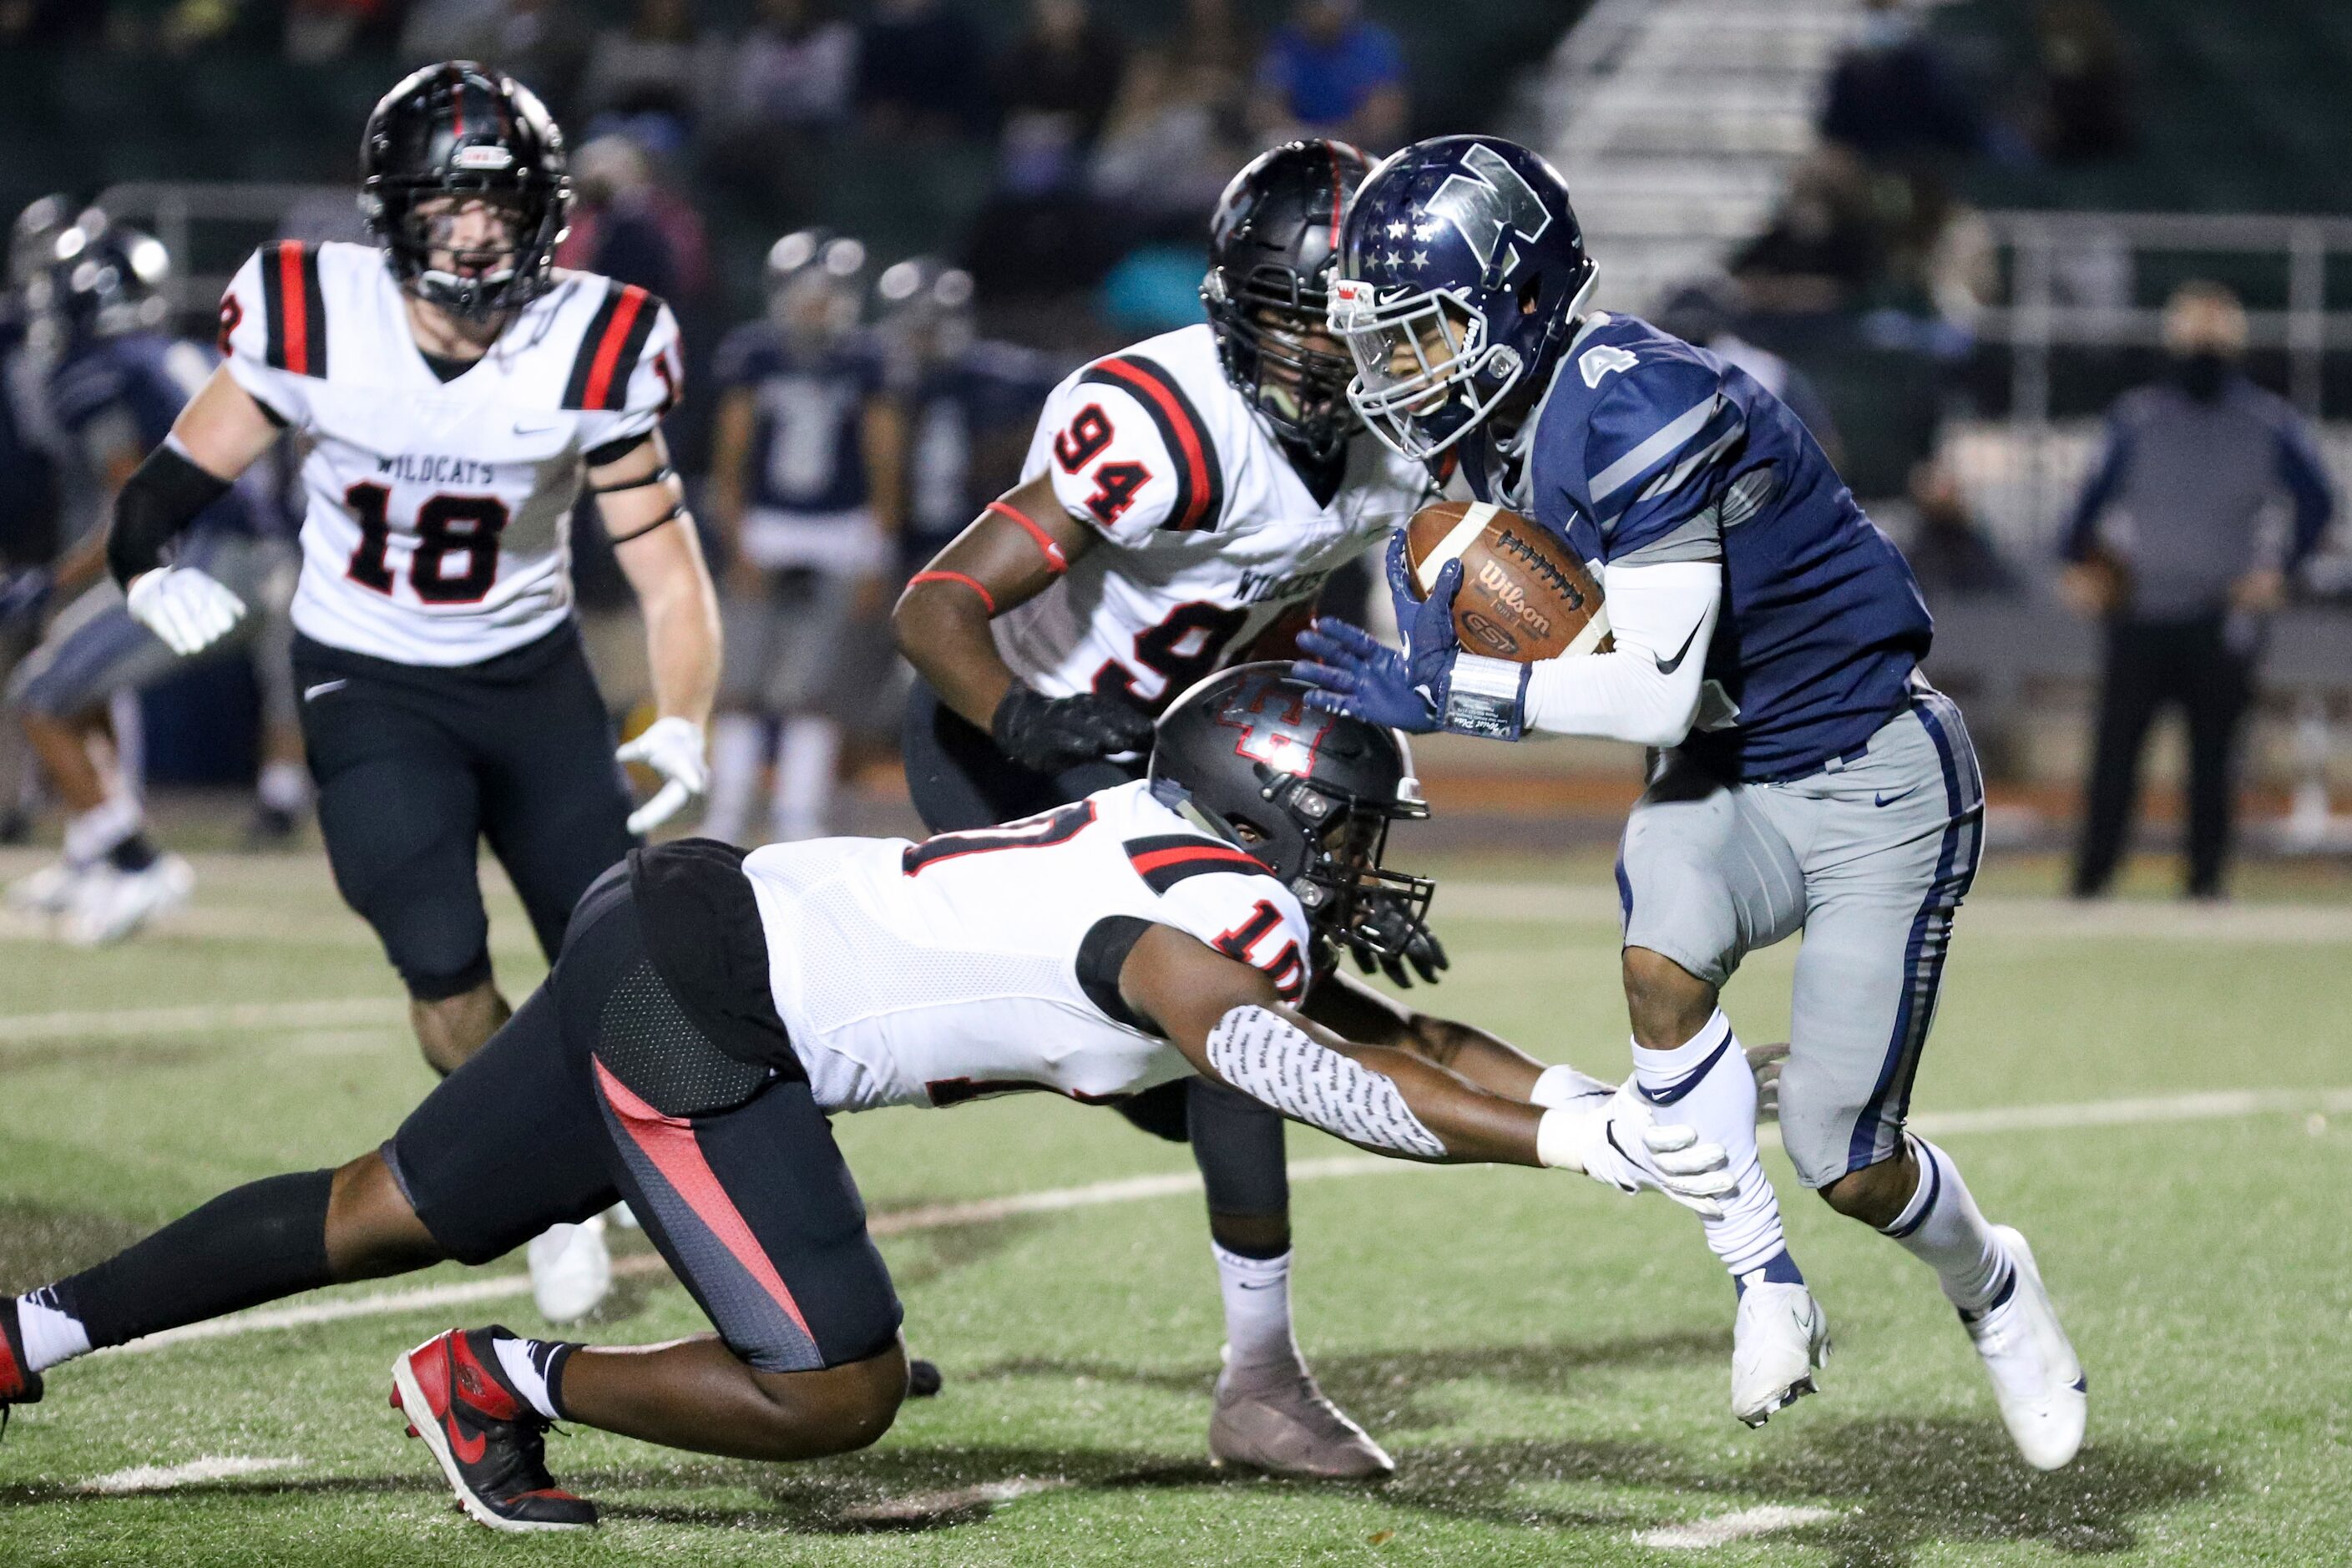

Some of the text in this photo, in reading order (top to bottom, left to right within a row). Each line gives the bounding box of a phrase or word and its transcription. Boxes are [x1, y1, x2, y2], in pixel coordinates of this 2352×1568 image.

[1578, 344, 1640, 389] 4
[377, 453, 494, 484] WILDCATS
[1053, 402, 1154, 528] 94
[344, 477, 510, 604] 18
[1479, 559, 1551, 635] Wilson
[1466, 613, 1511, 651] GST
[1454, 716, 1474, 729] Plan
[1475, 720, 1500, 733] Wrist
